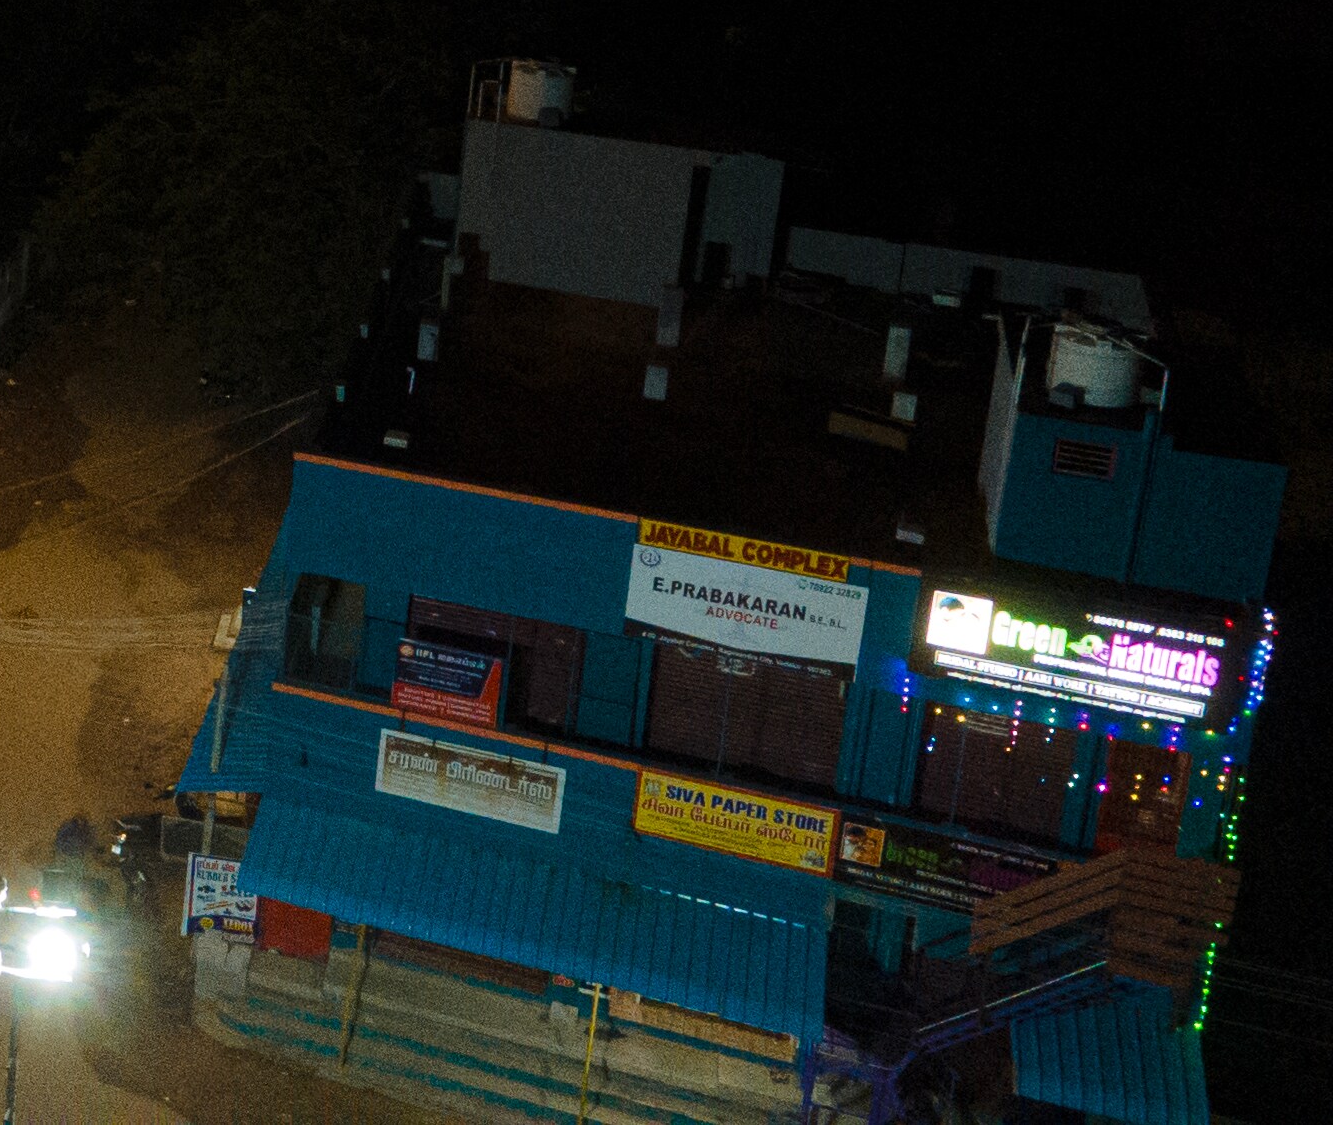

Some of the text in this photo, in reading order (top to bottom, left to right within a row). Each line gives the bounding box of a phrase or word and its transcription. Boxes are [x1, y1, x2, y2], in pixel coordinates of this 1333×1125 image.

[645, 525, 848, 579] JAYABAL COMPLEX
[652, 577, 807, 621] E.PRABAKARAN
[705, 606, 779, 630] ADVOCATE
[991, 610, 1221, 687] Green Naturals
[666, 785, 706, 807] SIVA
[710, 795, 767, 820] PAPER
[773, 809, 826, 834] STORE
